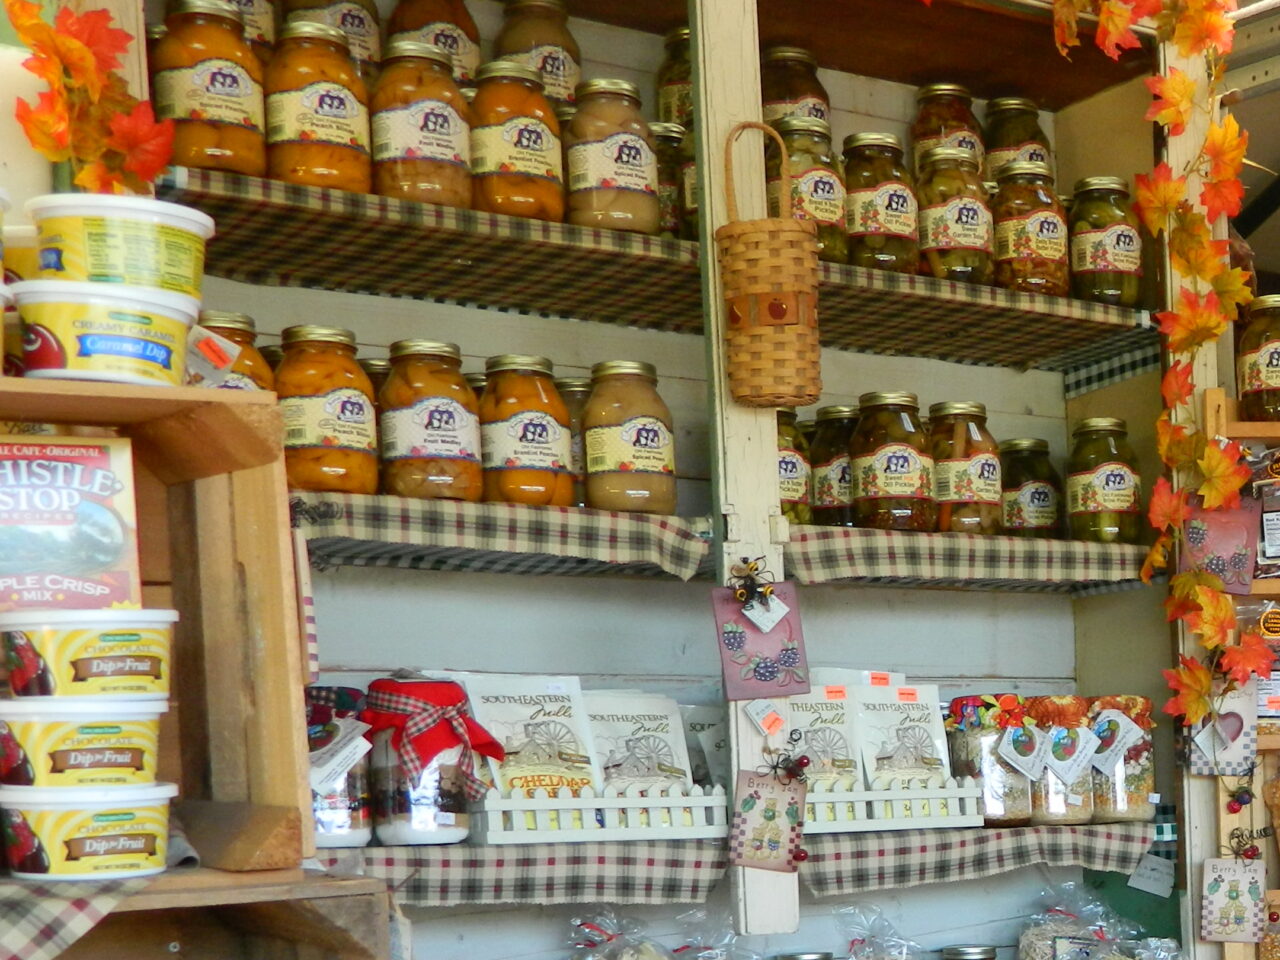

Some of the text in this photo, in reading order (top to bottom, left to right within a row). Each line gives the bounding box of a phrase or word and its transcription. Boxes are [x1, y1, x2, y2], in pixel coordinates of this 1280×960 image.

[146, 340, 168, 362] Dip
[0, 487, 81, 511] STOP
[45, 574, 111, 596] CRISP
[23, 590, 53, 601] MIX
[92, 658, 151, 675] Dip Fruit
[480, 695, 571, 706] SOUTHEASTERN
[790, 702, 845, 713] THEASTERN
[863, 702, 929, 713] SOUTHEASTERN
[530, 705, 573, 720] Mills
[588, 713, 670, 724] SOUTHEASTERN
[810, 711, 846, 727] Mills
[899, 713, 931, 726] Mills
[69, 751, 132, 767] Dip Fruit
[748, 777, 799, 794] Berry Jam
[84, 837, 146, 855] Dip Fruit
[1211, 863, 1258, 877] Berry Jam
